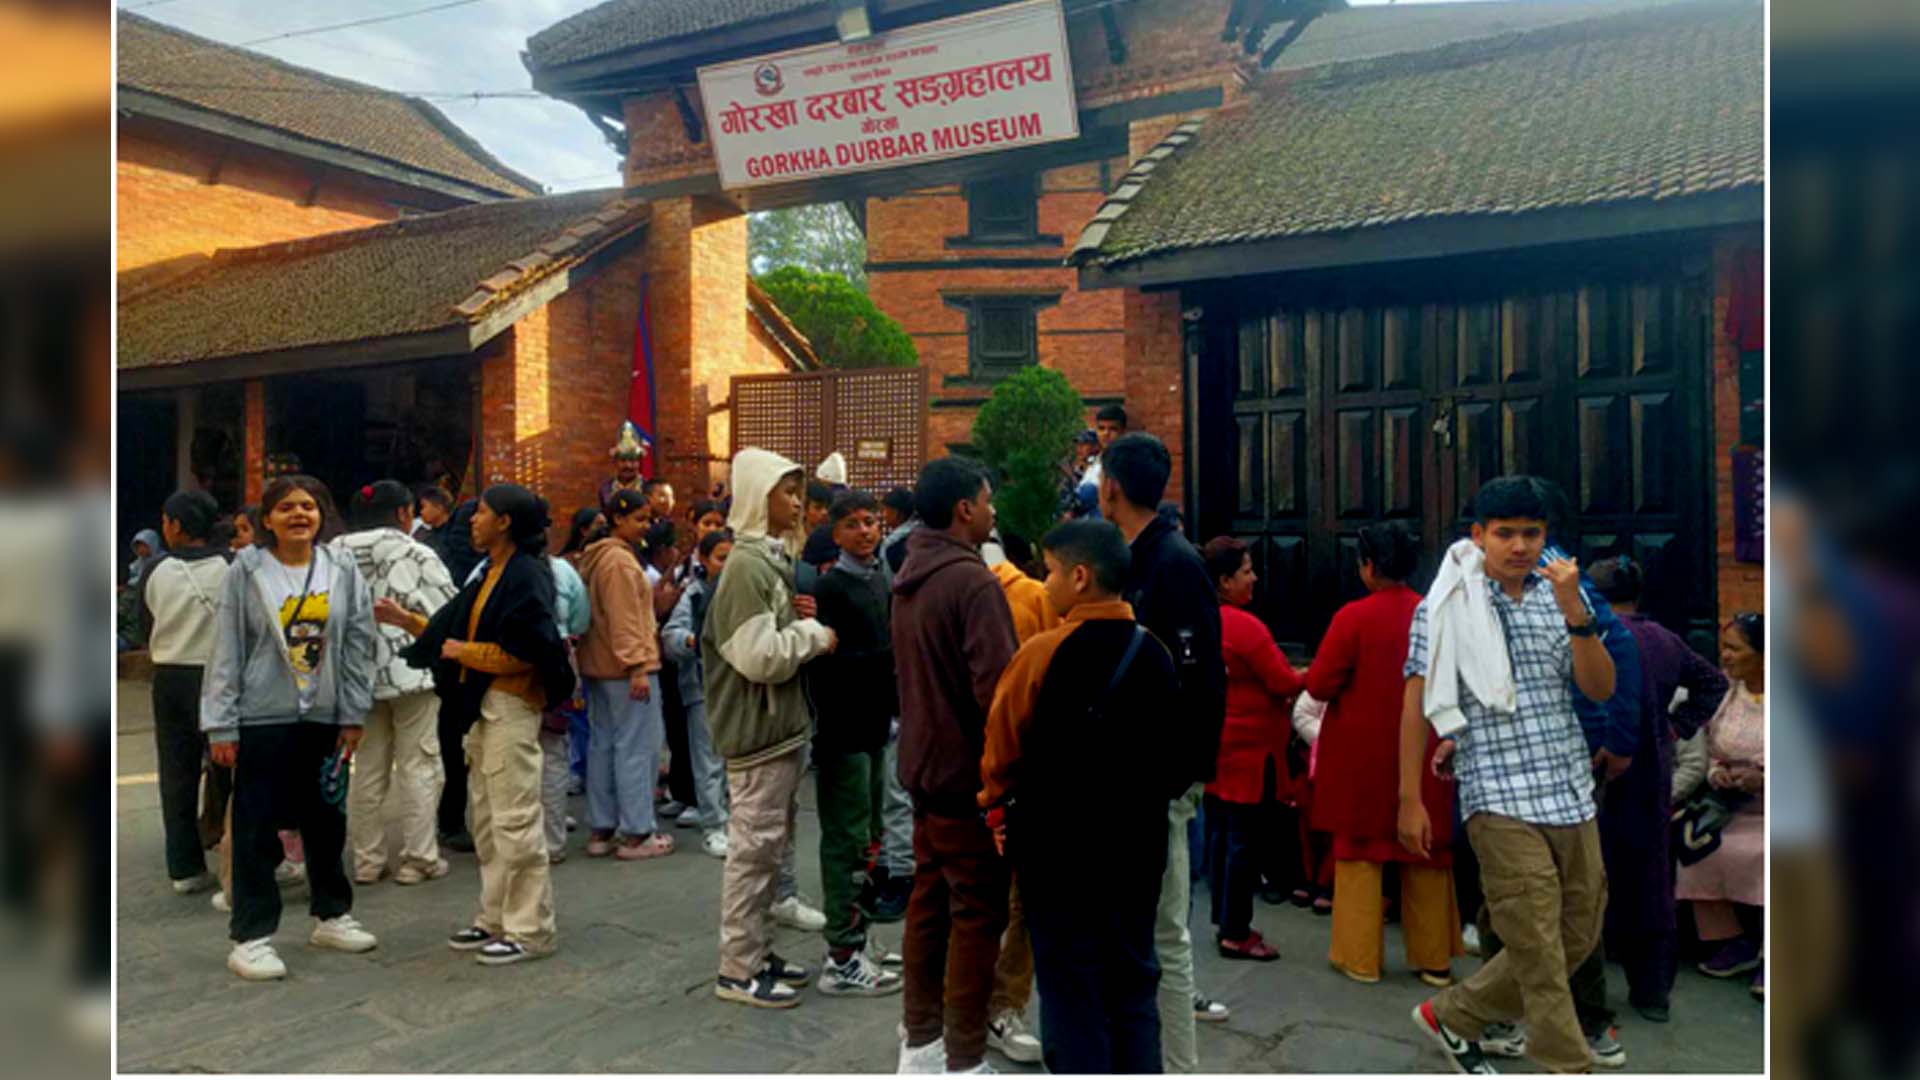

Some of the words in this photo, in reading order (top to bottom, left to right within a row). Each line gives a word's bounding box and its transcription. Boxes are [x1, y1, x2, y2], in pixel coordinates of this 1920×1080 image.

[719, 101, 798, 134] गोरखा
[804, 84, 886, 121] दरबार
[746, 146, 832, 178] GORKHA
[835, 131, 927, 165] DURBAR
[932, 112, 1042, 150] MUSEUM
